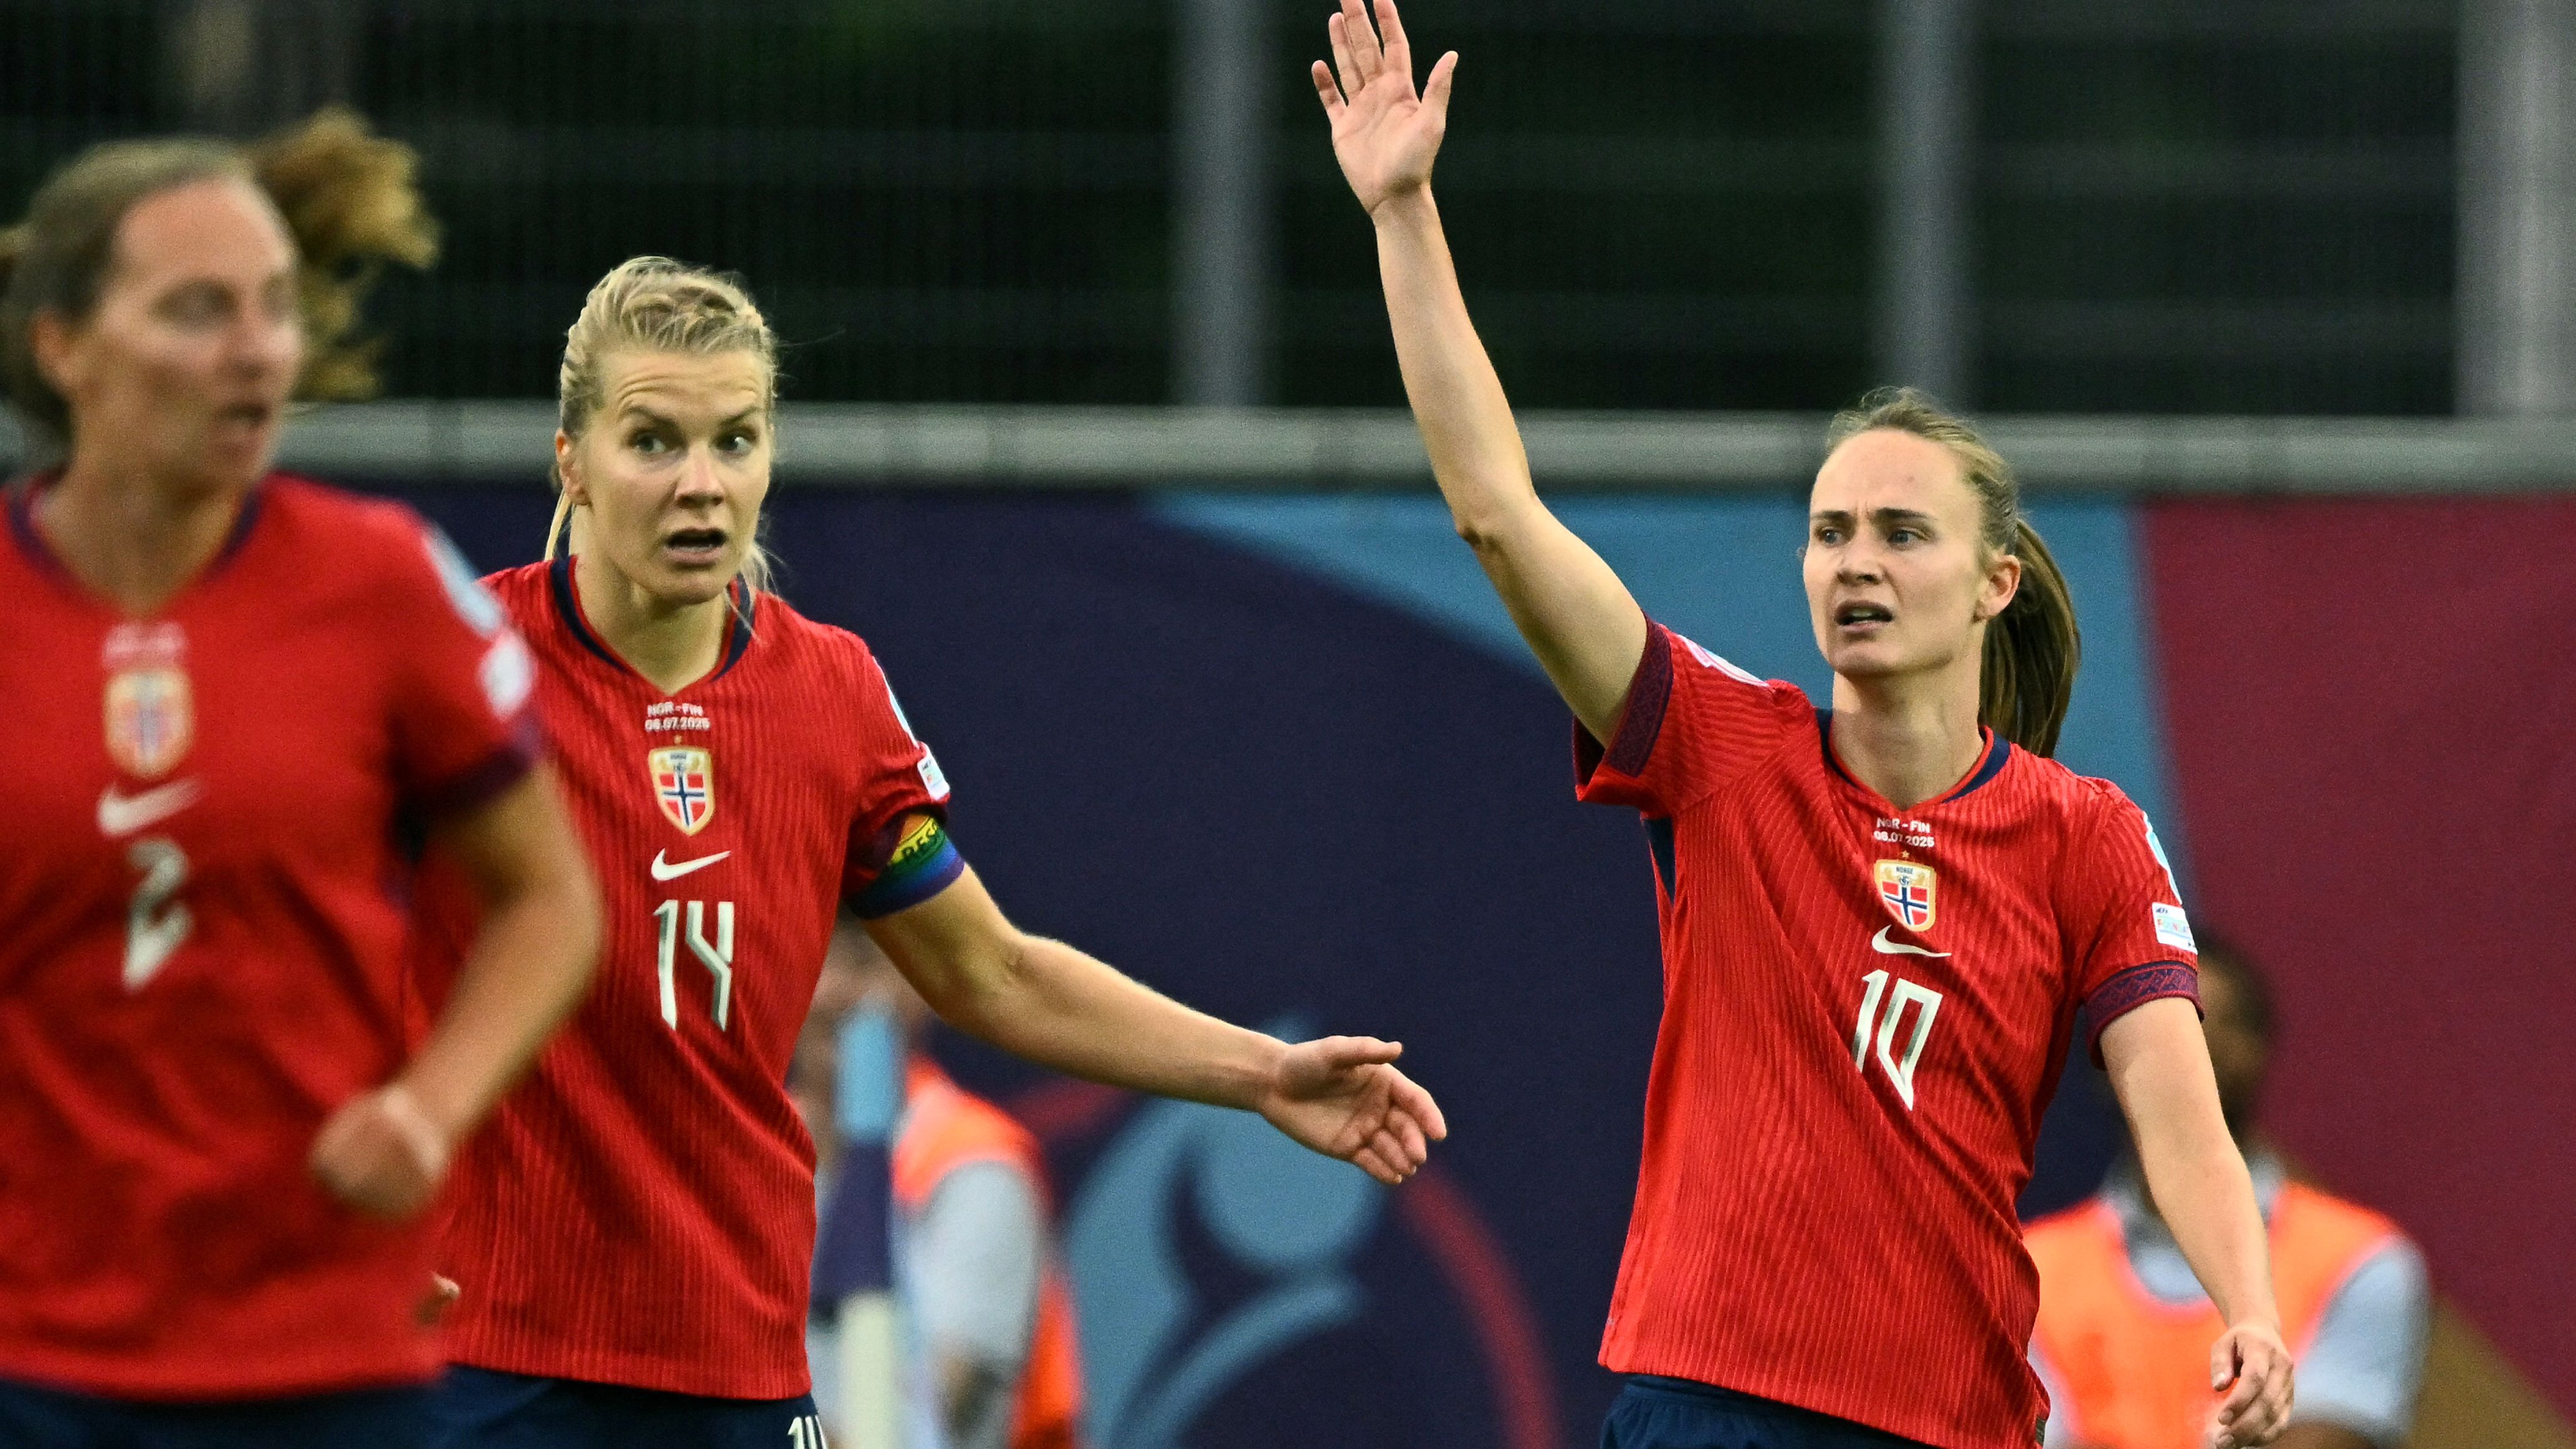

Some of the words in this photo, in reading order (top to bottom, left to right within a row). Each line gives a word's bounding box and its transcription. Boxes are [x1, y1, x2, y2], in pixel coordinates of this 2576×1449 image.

[122, 837, 194, 992] 2
[653, 900, 734, 1032] 14
[1852, 969, 1944, 1111] 10
